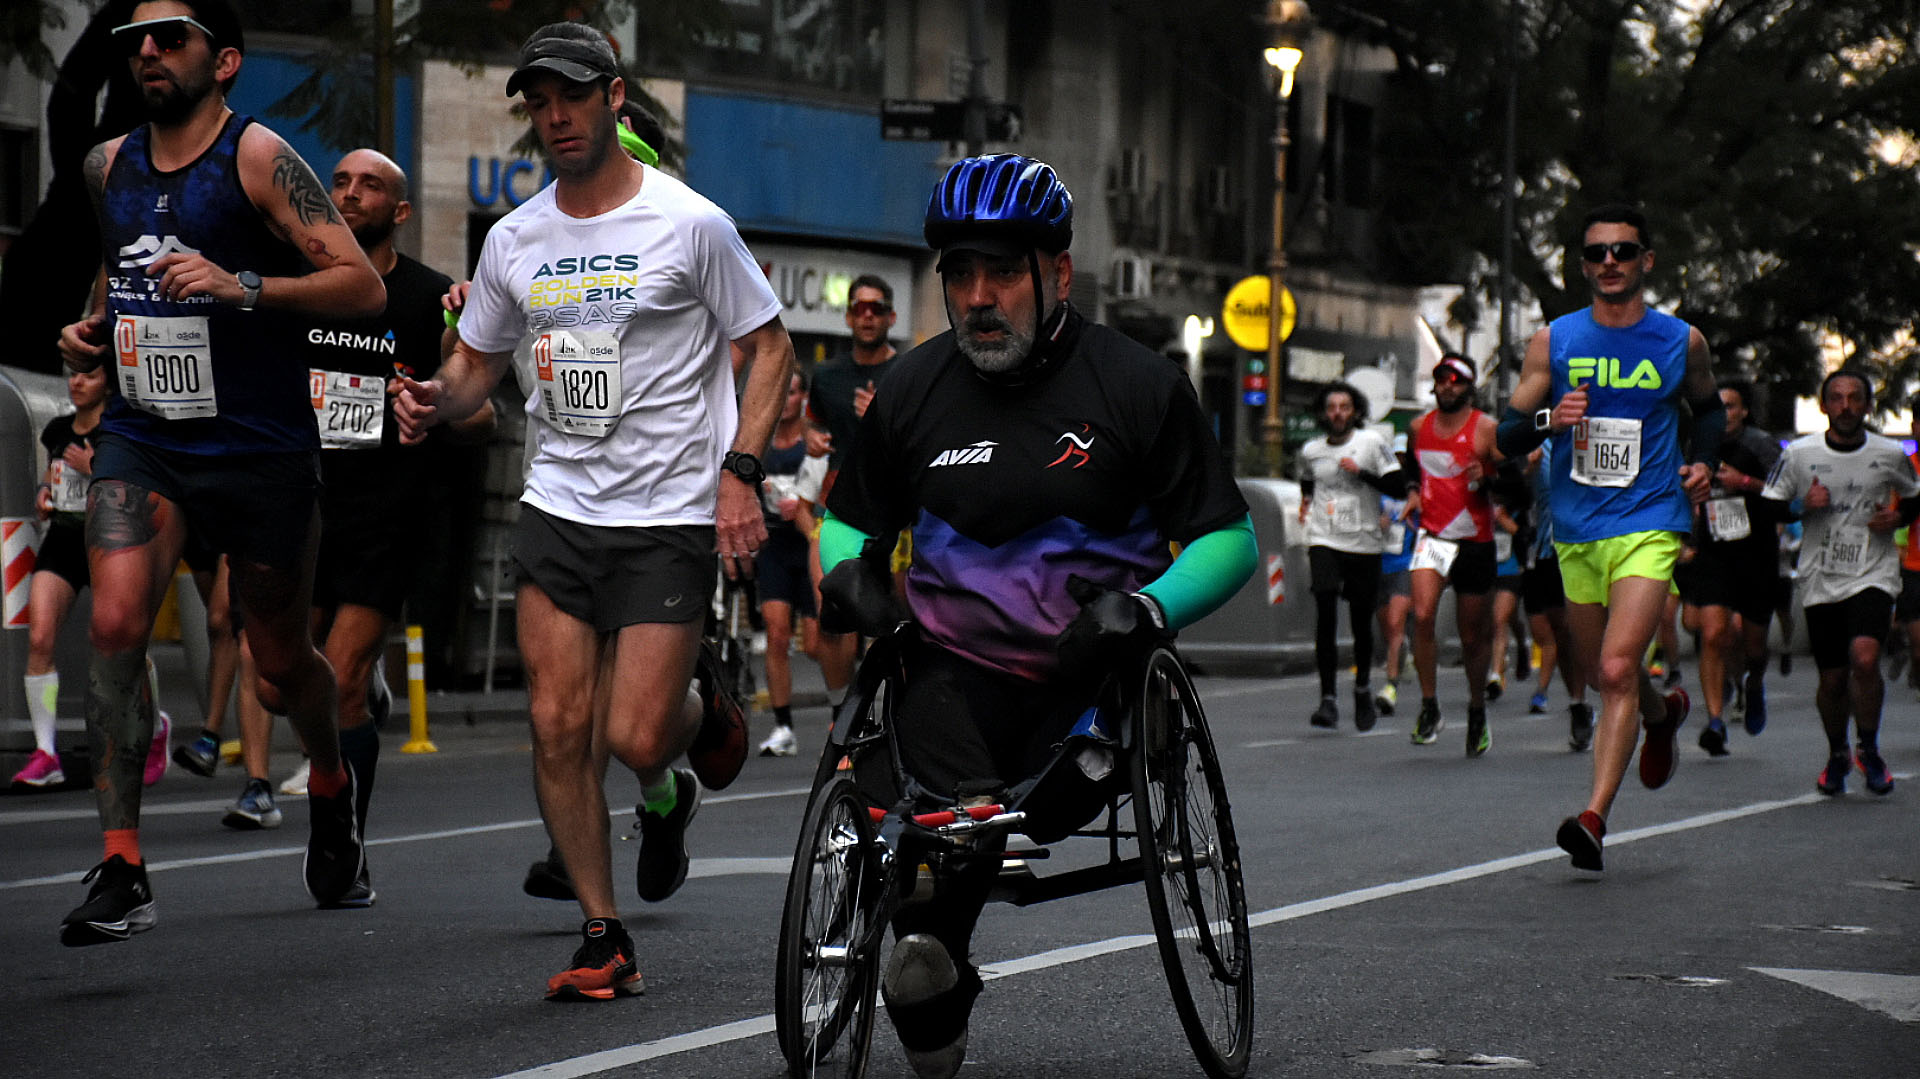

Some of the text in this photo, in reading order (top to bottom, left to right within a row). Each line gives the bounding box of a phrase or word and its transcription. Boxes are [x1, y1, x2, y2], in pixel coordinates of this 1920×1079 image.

[532, 254, 639, 279] ASICS
[530, 275, 639, 294] GOLDEN
[530, 288, 636, 308] RUN 21K
[531, 302, 639, 329] BSAS
[308, 329, 396, 355] GARMIN
[590, 346, 614, 355] osde
[145, 354, 200, 393] 1900
[1568, 357, 1662, 390] FILA
[560, 369, 609, 410] 1820
[328, 401, 374, 434] 2702
[928, 445, 995, 468] AVIA
[1594, 443, 1631, 471] 1654
